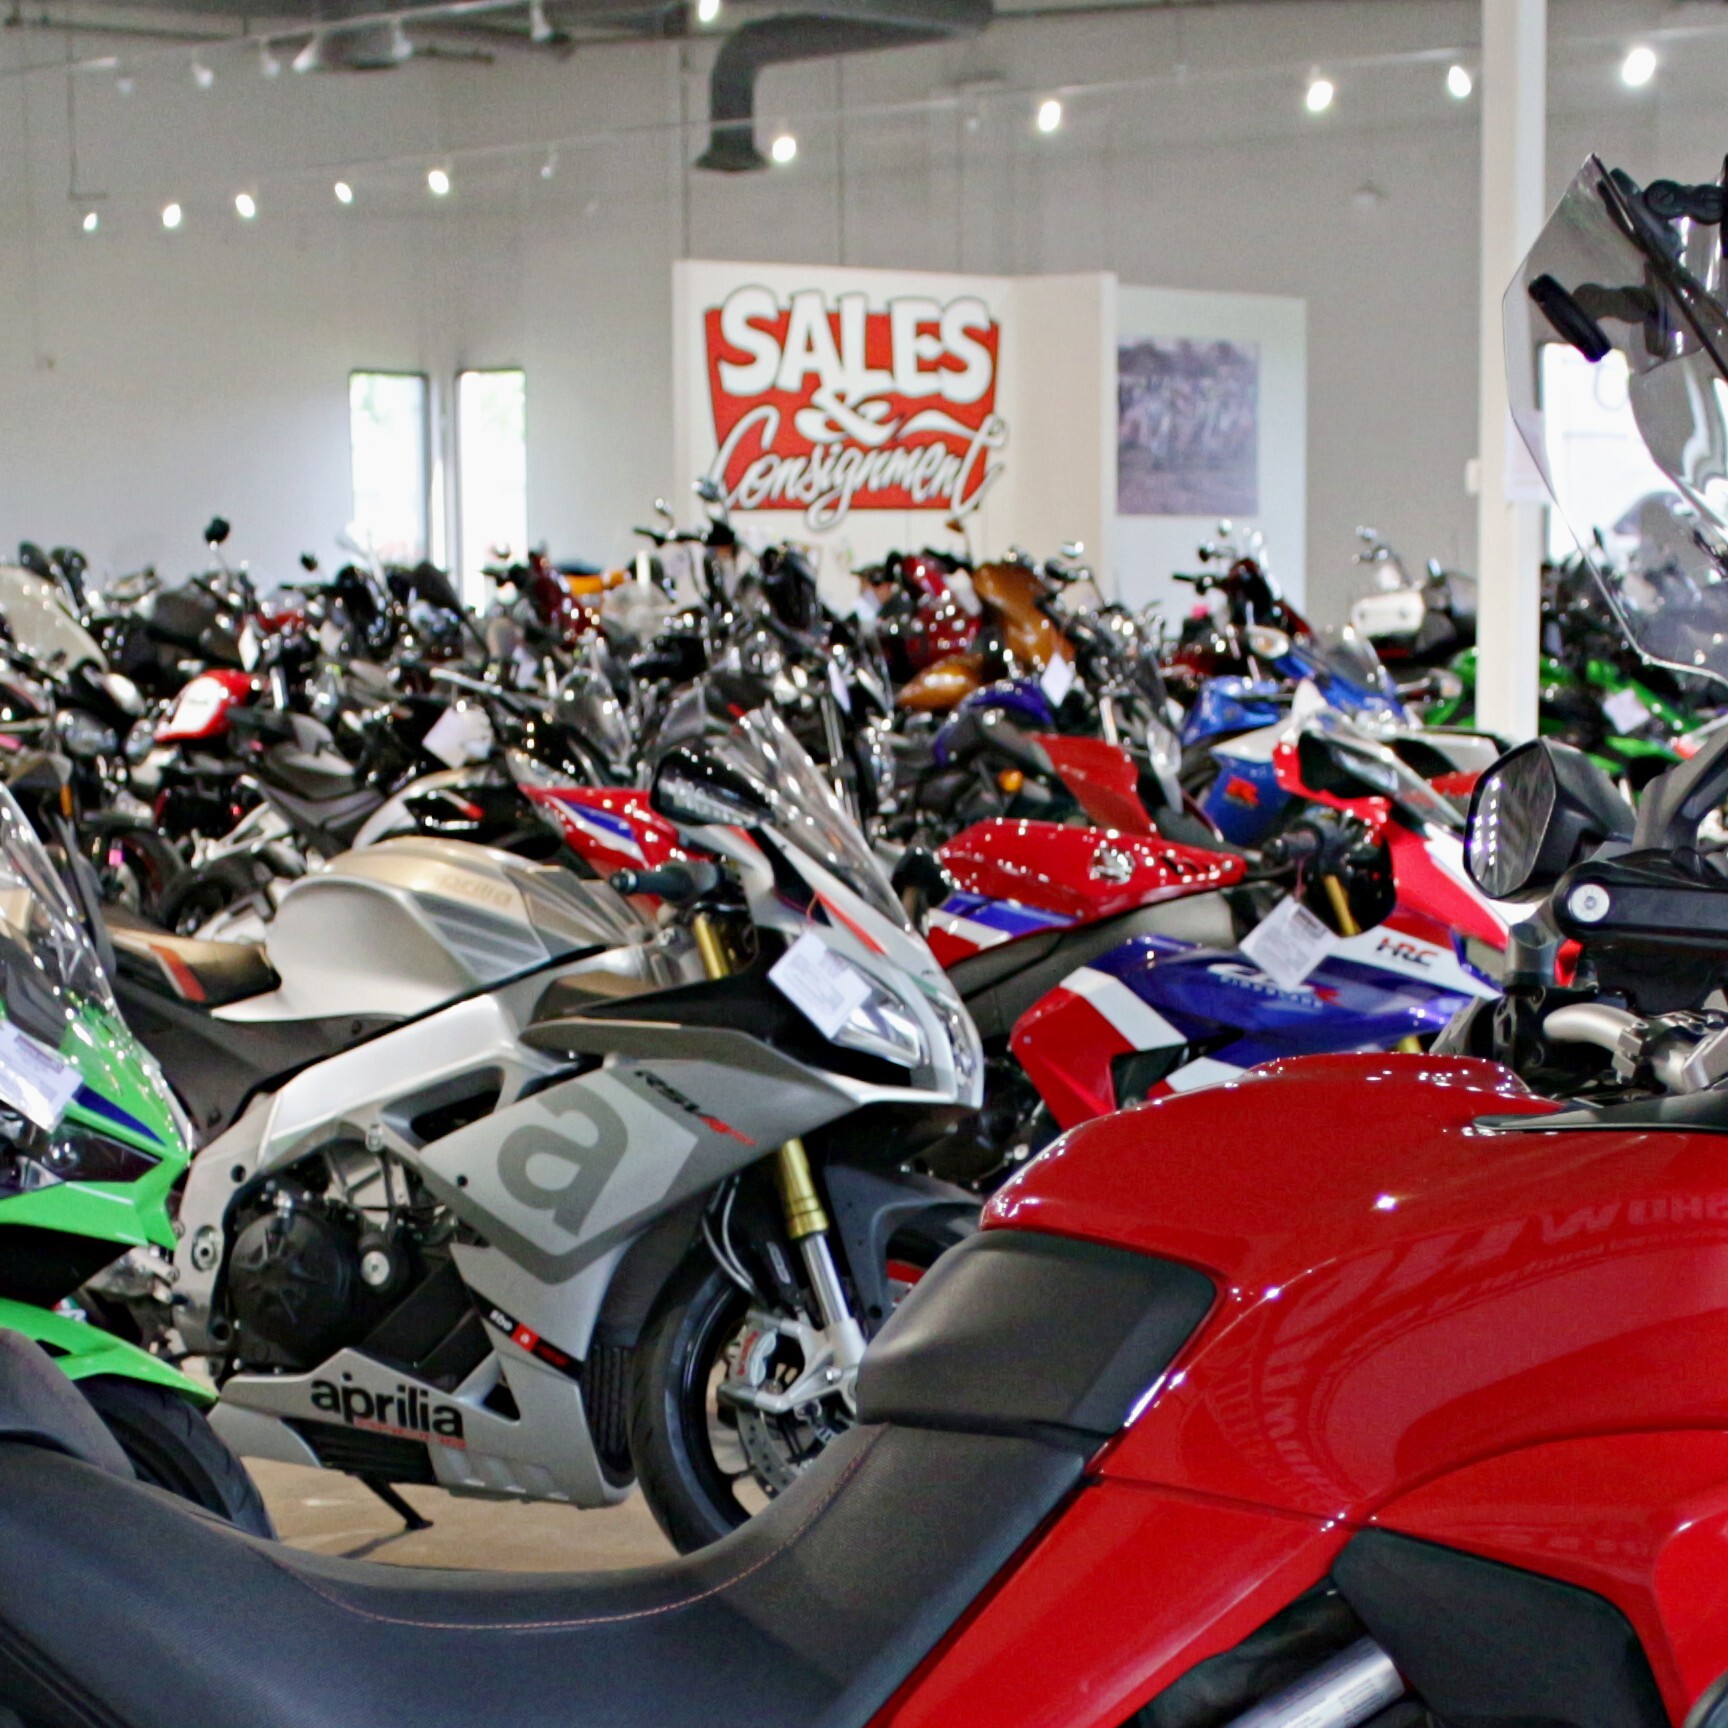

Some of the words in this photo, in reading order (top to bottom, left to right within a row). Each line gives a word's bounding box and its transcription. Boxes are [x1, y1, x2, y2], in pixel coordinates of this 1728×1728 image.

[719, 284, 994, 403] SALES
[794, 383, 906, 447] &
[710, 403, 1008, 532] Consignment
[1374, 936, 1439, 968] HRC
[310, 1371, 465, 1441] aprilia
